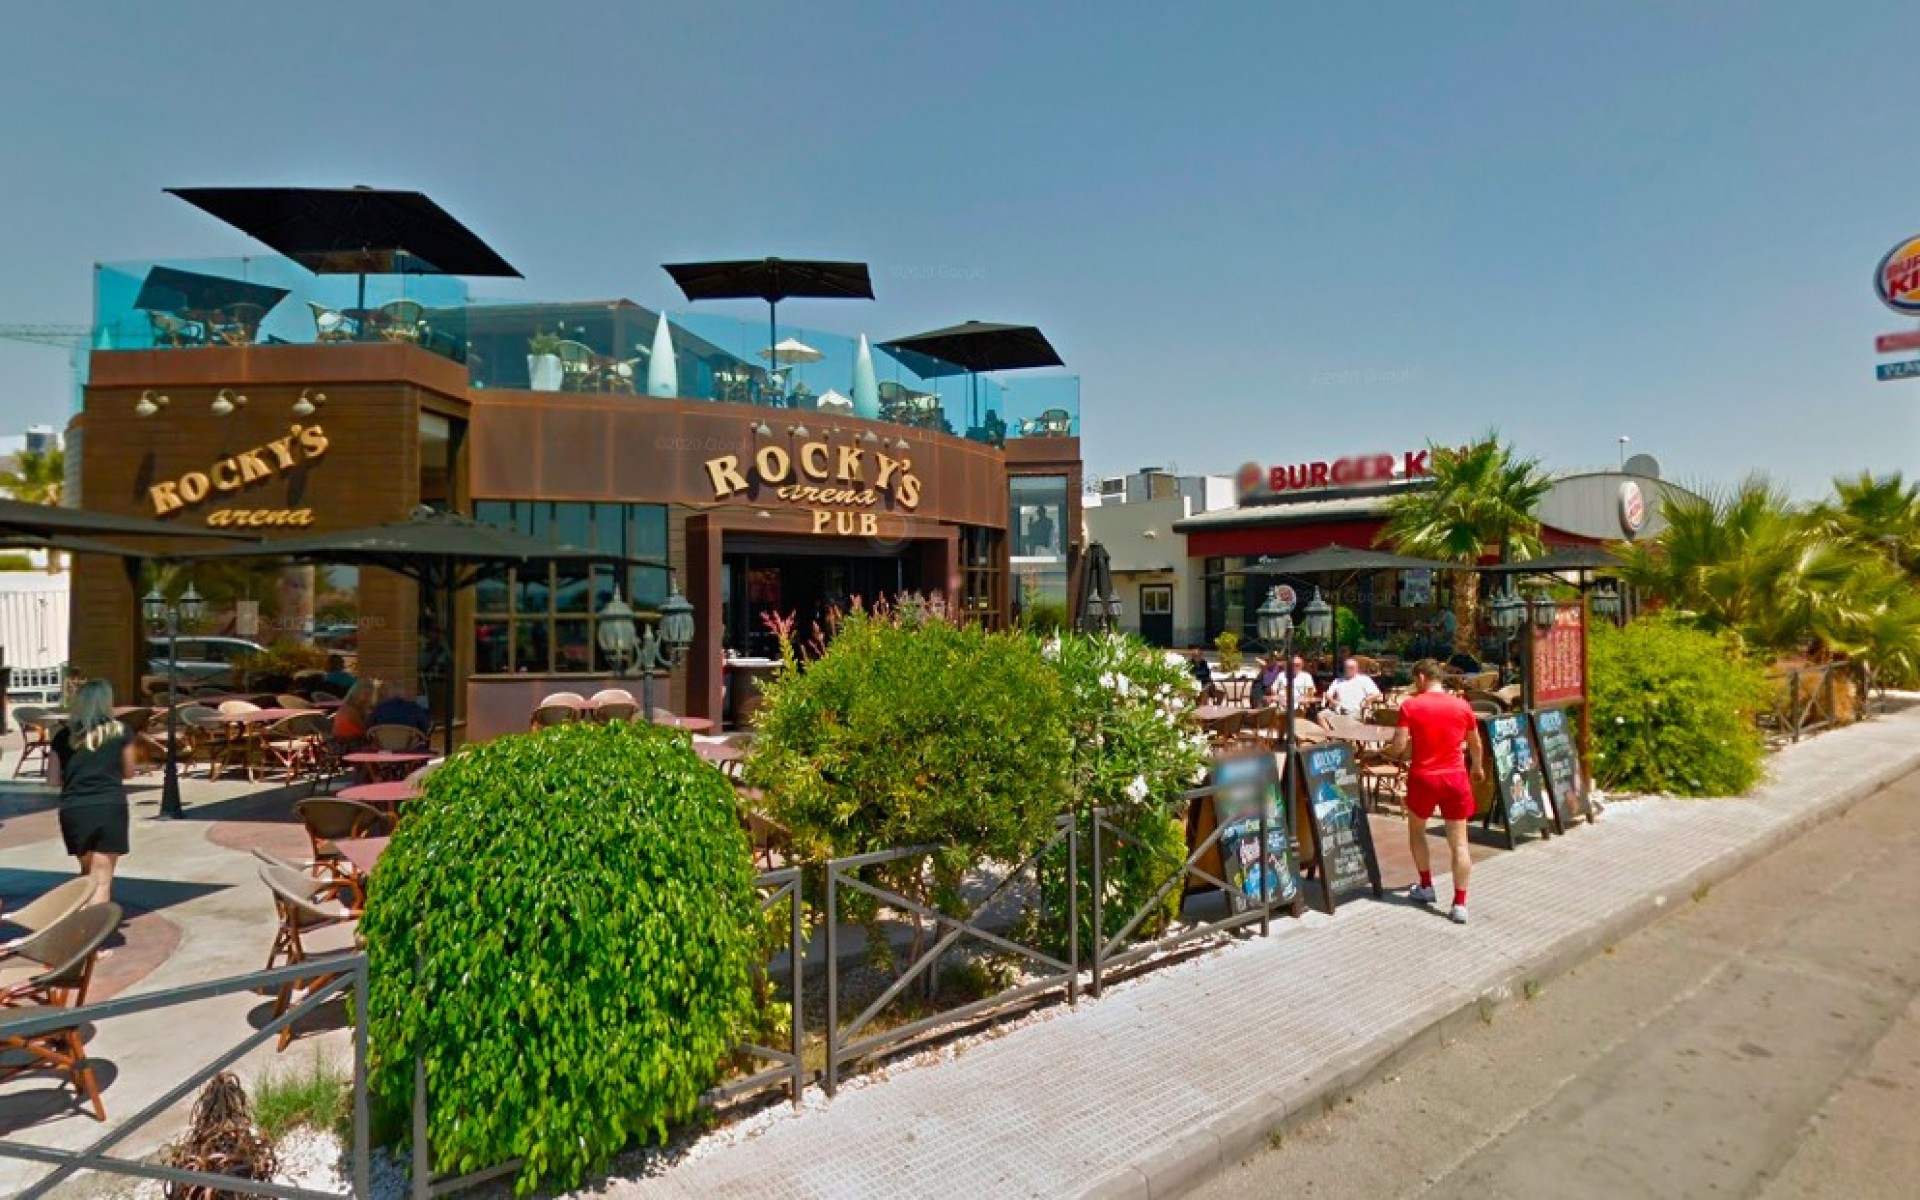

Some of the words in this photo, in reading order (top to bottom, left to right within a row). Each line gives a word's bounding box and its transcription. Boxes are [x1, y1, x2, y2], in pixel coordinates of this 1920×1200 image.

[149, 424, 329, 515] ROCKY'S
[705, 442, 922, 509] ROCKY'S
[1267, 454, 1395, 492] BURGER
[776, 484, 878, 506] arena
[206, 508, 316, 527] arena
[812, 510, 879, 537] PUB
